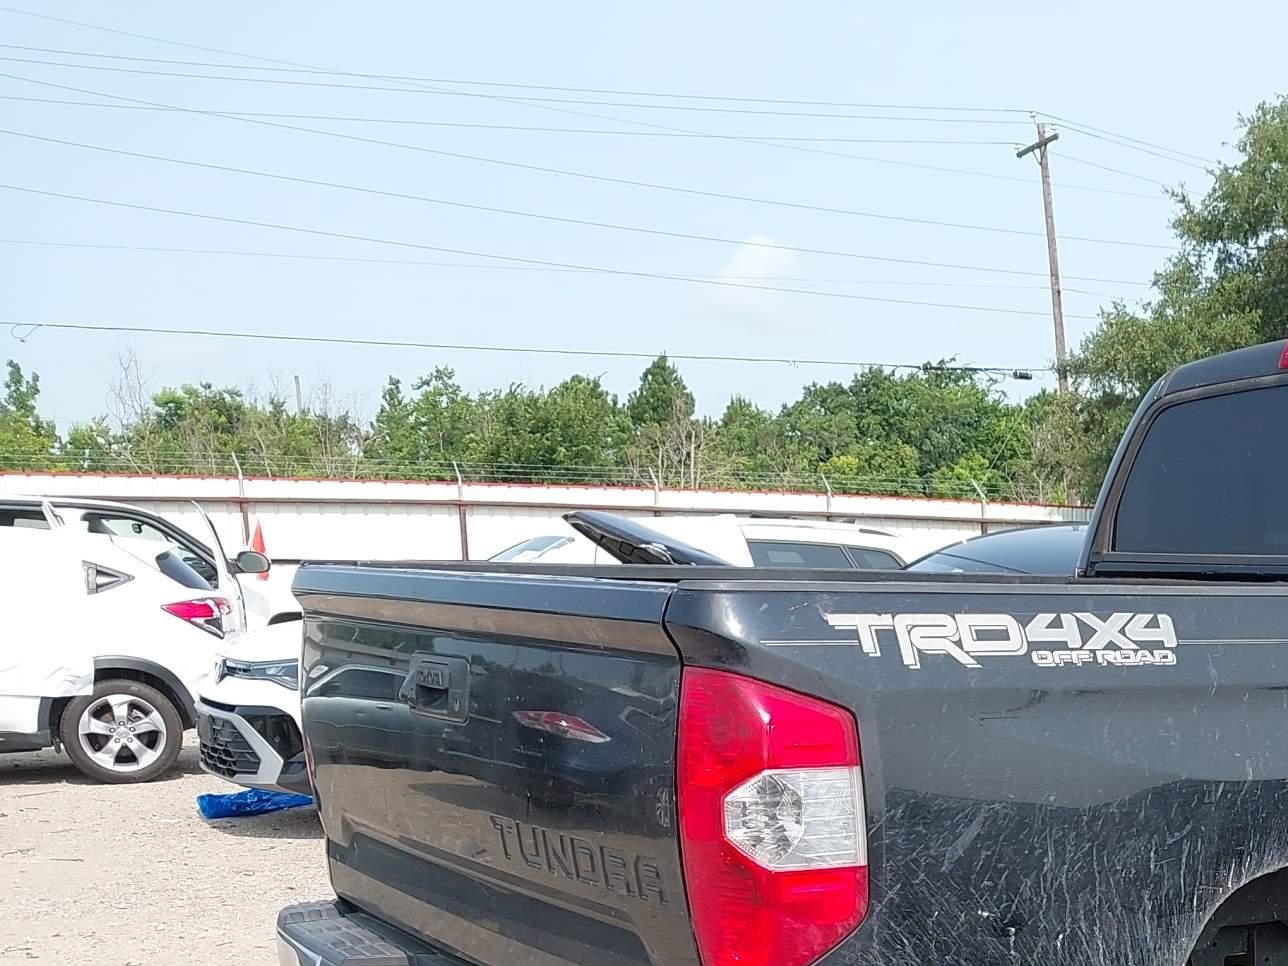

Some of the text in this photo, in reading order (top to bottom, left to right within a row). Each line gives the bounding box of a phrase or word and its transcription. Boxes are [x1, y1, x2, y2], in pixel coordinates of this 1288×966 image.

[826, 612, 1028, 669] TRD
[1031, 650, 1177, 668] OFF ROAD
[489, 813, 669, 905] TUNDRA
